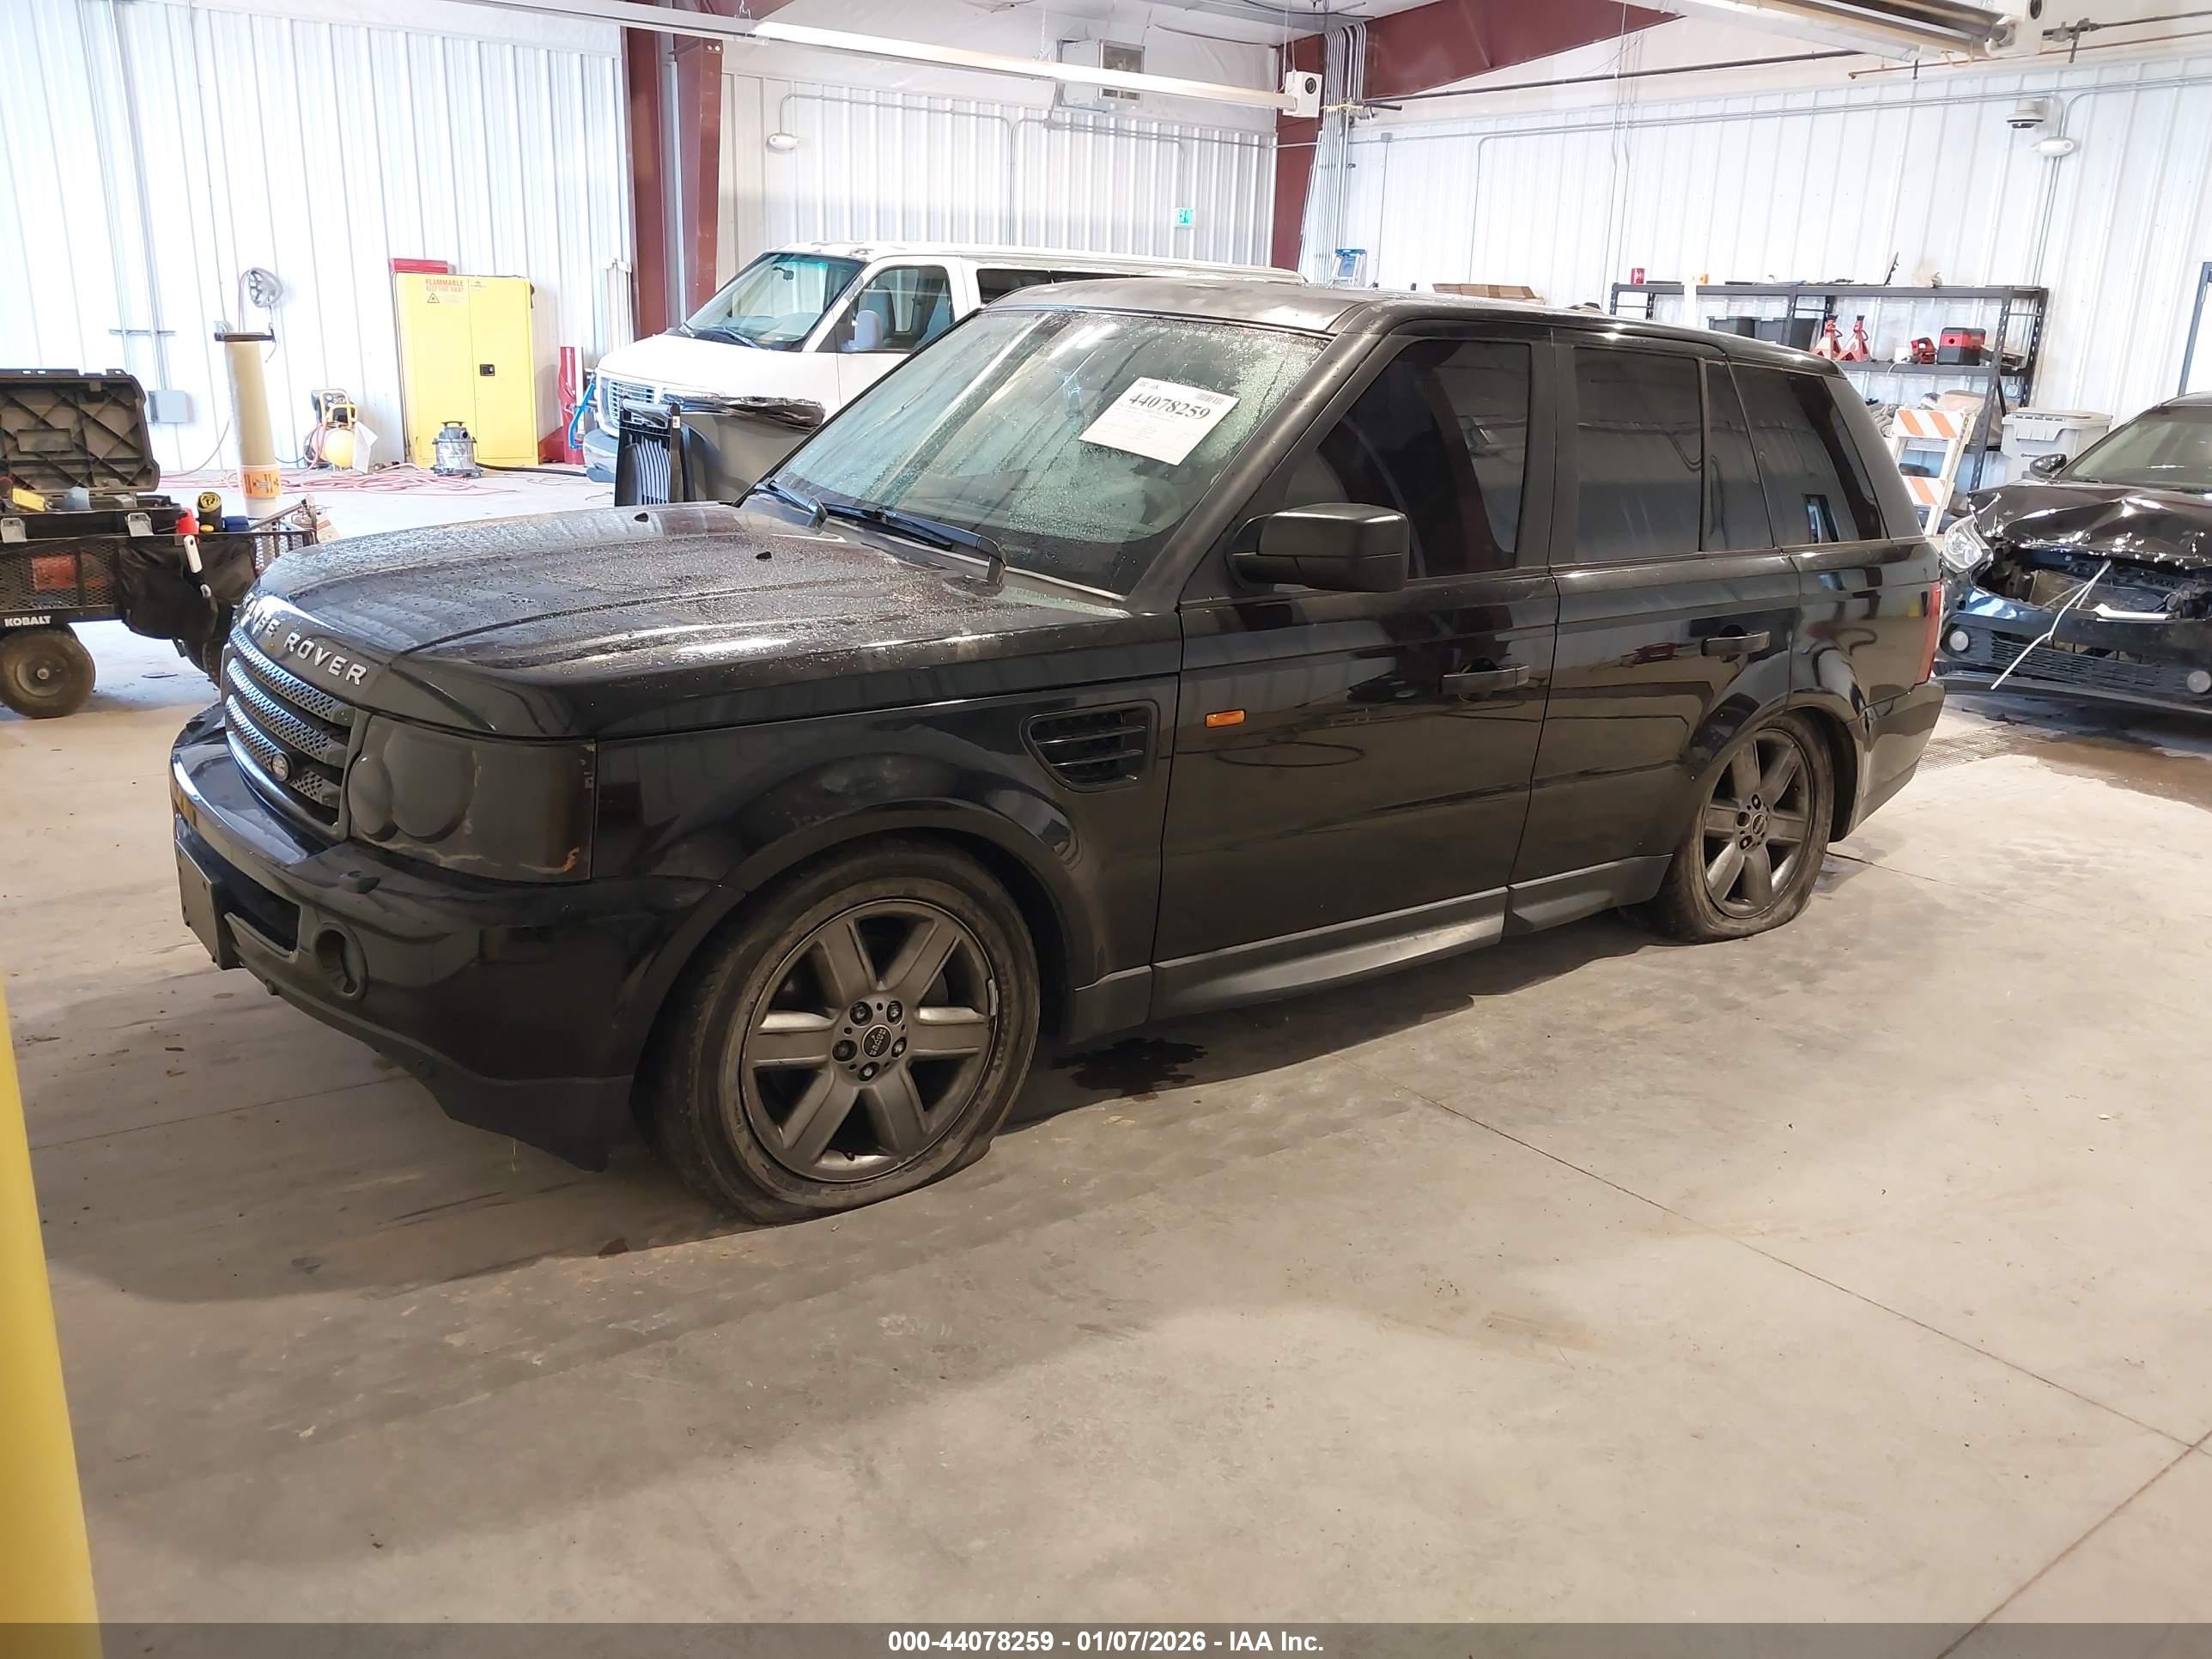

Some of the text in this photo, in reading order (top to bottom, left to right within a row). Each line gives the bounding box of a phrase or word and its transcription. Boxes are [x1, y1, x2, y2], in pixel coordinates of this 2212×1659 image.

[425, 278, 464, 287] FLAMMABLE
[1129, 393, 1211, 419] 44078259
[4, 615, 52, 627] KOBALT
[283, 631, 367, 685] ROVER
